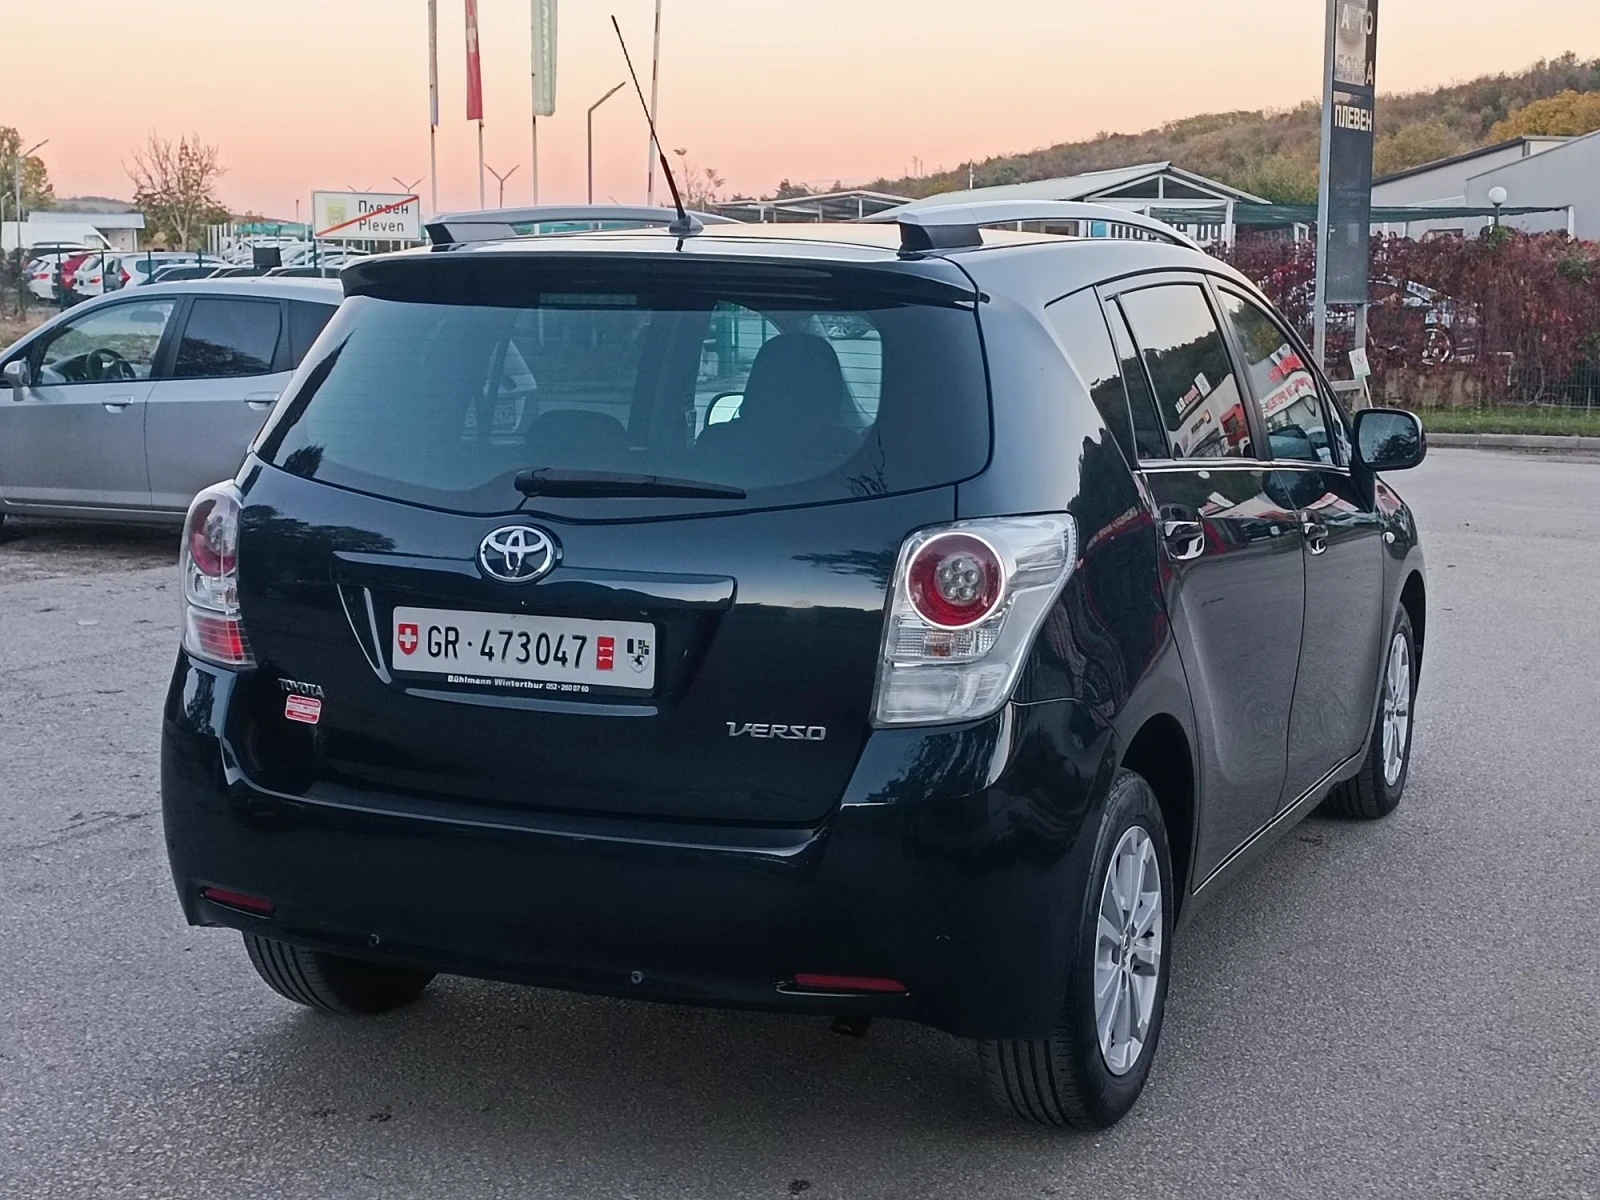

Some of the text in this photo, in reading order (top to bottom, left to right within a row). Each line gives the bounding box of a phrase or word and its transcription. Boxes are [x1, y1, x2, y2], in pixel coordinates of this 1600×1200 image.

[1341, 4, 1374, 35] АТО
[1334, 105, 1373, 132] ПЛЕВЕН
[358, 200, 409, 215] Плевен
[359, 218, 404, 232] Pleven
[277, 677, 326, 699] TOYOTA
[447, 675, 492, 685] Bühlmann
[494, 678, 543, 689] Winterthur
[726, 721, 826, 741] VERSO
